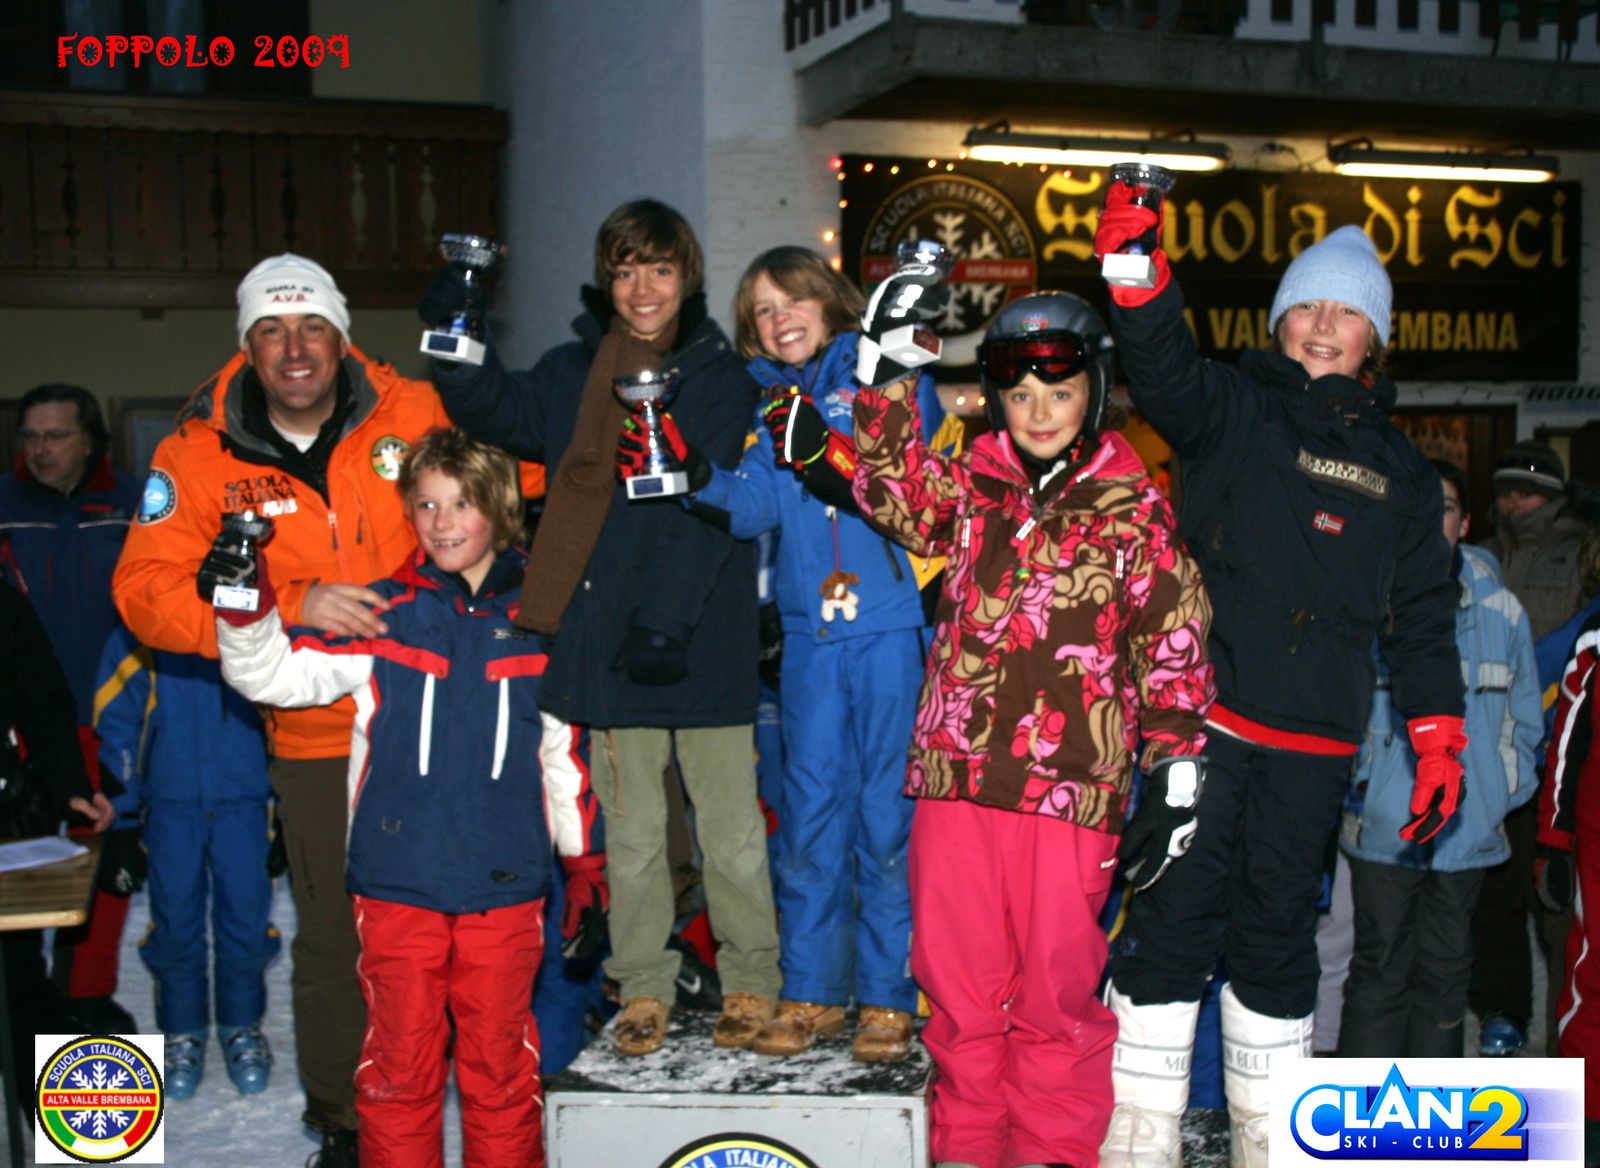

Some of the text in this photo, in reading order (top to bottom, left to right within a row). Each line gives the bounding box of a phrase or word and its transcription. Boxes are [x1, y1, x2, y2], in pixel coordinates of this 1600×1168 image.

[1036, 170, 1568, 269] Suola di Sci
[1388, 311, 1520, 351] EMBANA
[223, 486, 297, 510] ITALIANA
[224, 474, 292, 493] SCUOLA
